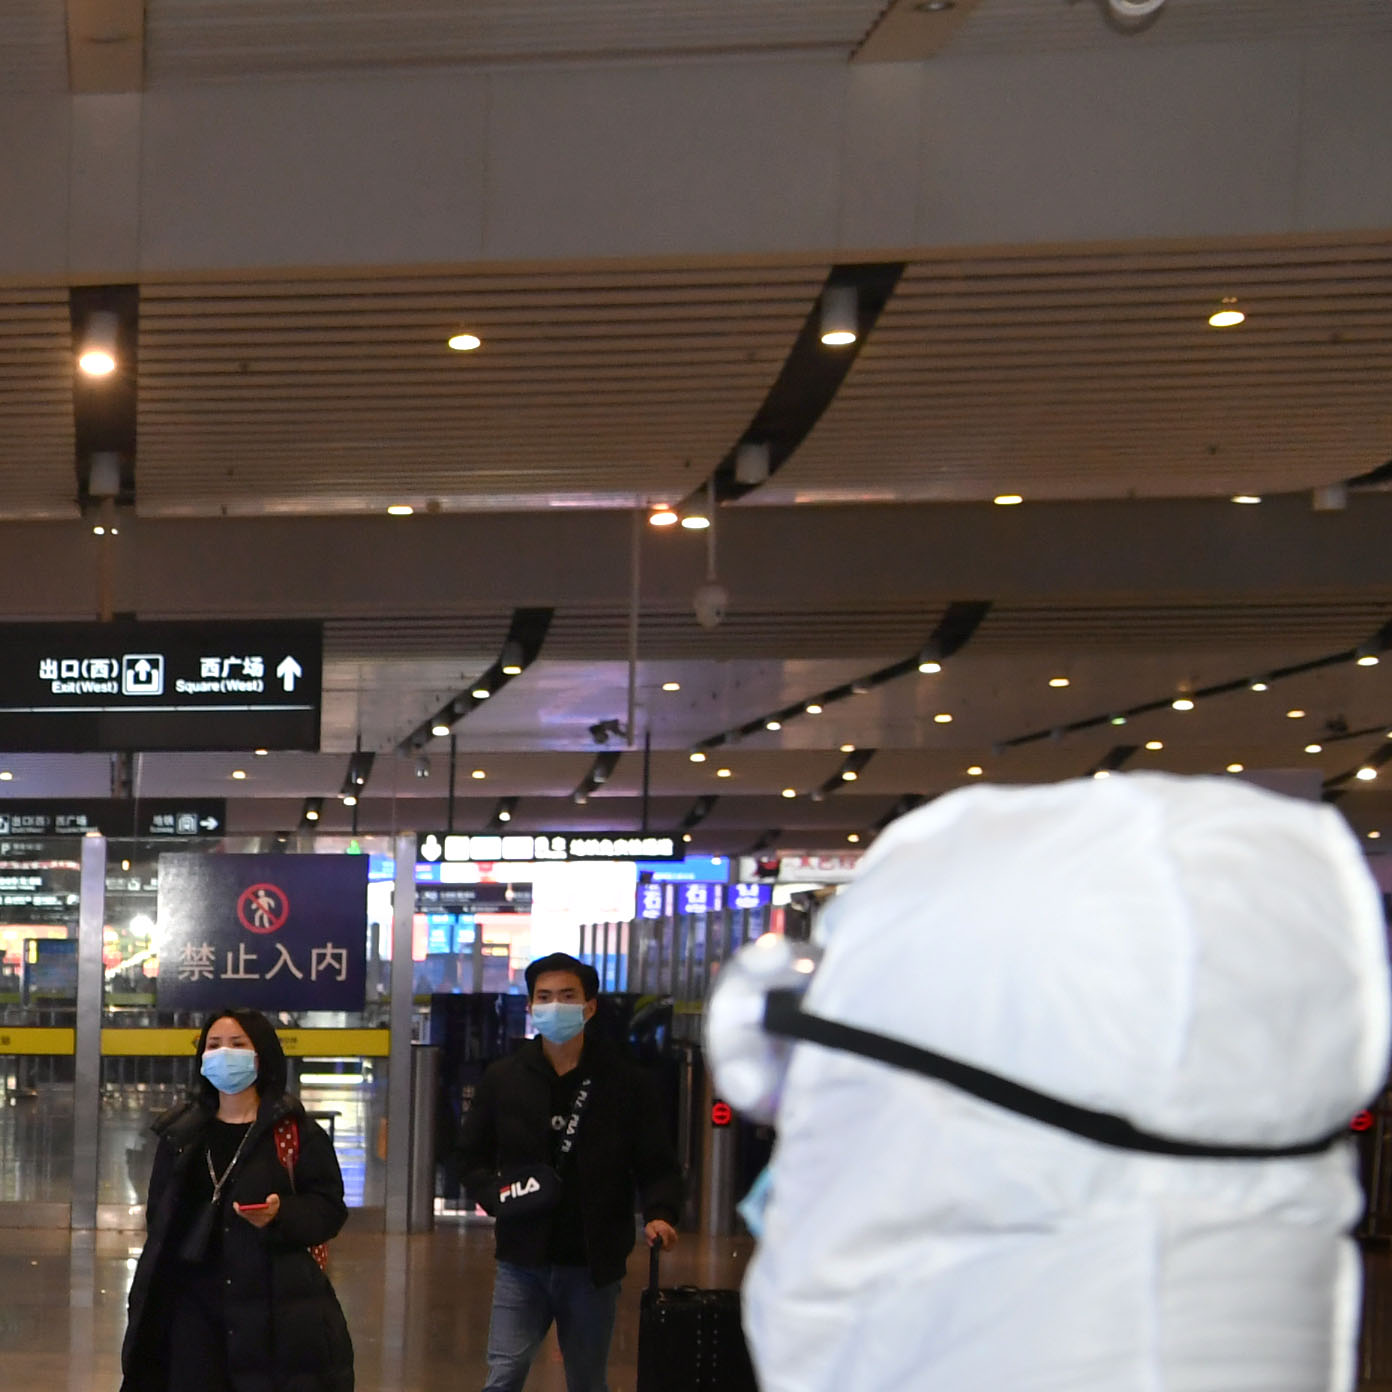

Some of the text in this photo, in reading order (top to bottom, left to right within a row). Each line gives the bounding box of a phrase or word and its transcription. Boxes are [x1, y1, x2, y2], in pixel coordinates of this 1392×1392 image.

[39, 657, 264, 679] 出口(西) 西广场
[52, 679, 264, 694] Exit(West) Square(West)
[178, 942, 349, 981] 禁止入内
[500, 1177, 540, 1203] FILA
